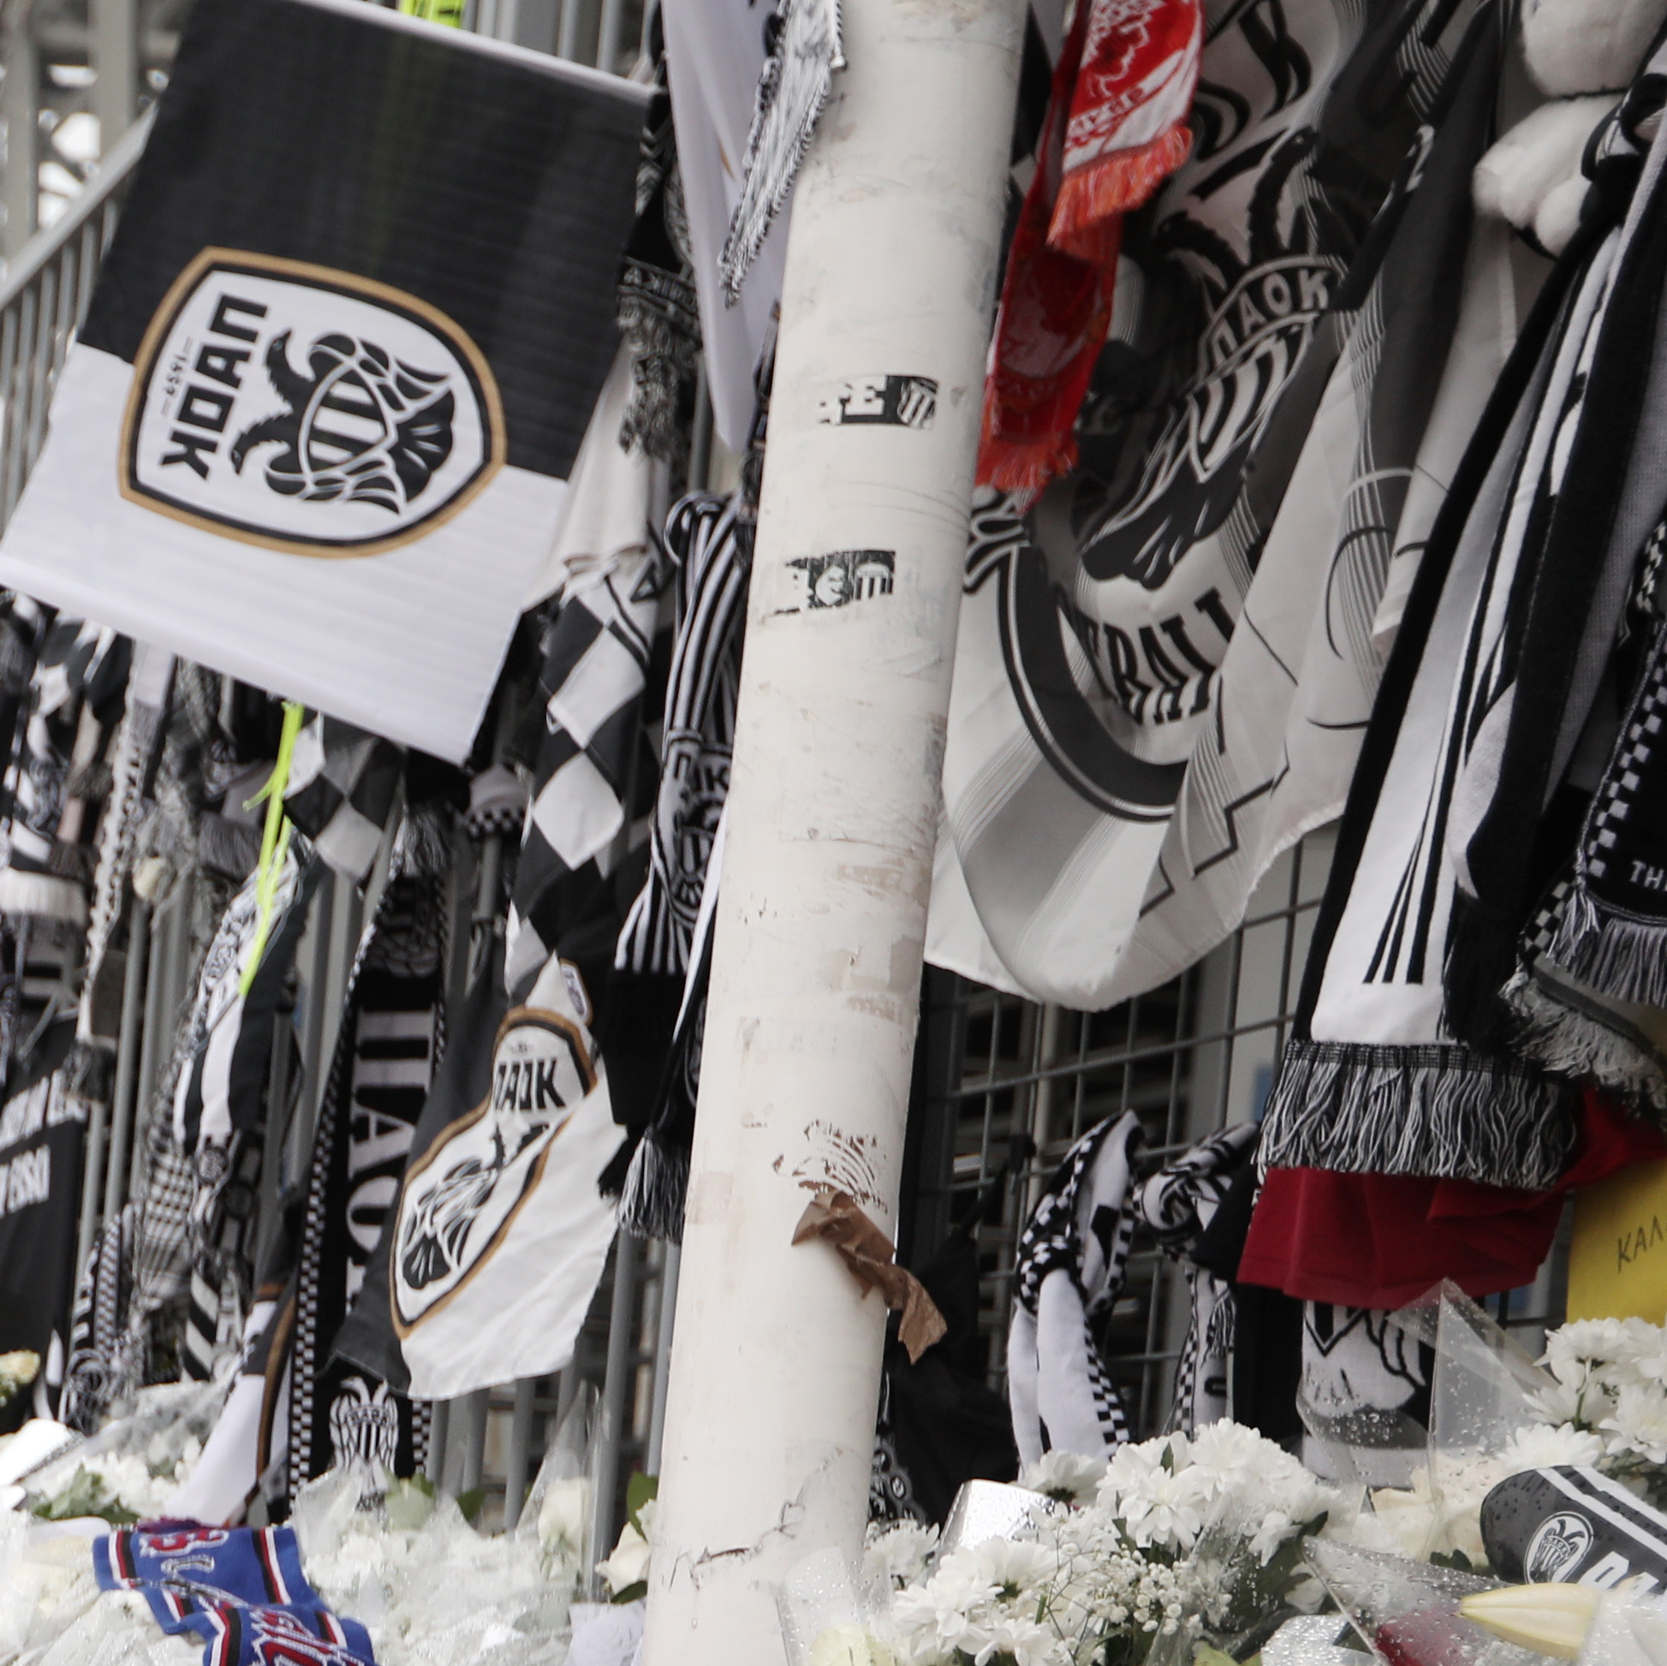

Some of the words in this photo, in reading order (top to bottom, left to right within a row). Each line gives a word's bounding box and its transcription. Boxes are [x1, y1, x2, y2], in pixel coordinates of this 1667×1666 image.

[160, 293, 268, 481] ΠΑΟΚ
[1629, 859, 1667, 893] TH
[345, 1009, 436, 1317] ΠΑΟ
[1618, 1214, 1667, 1274] ΚΑΛ
